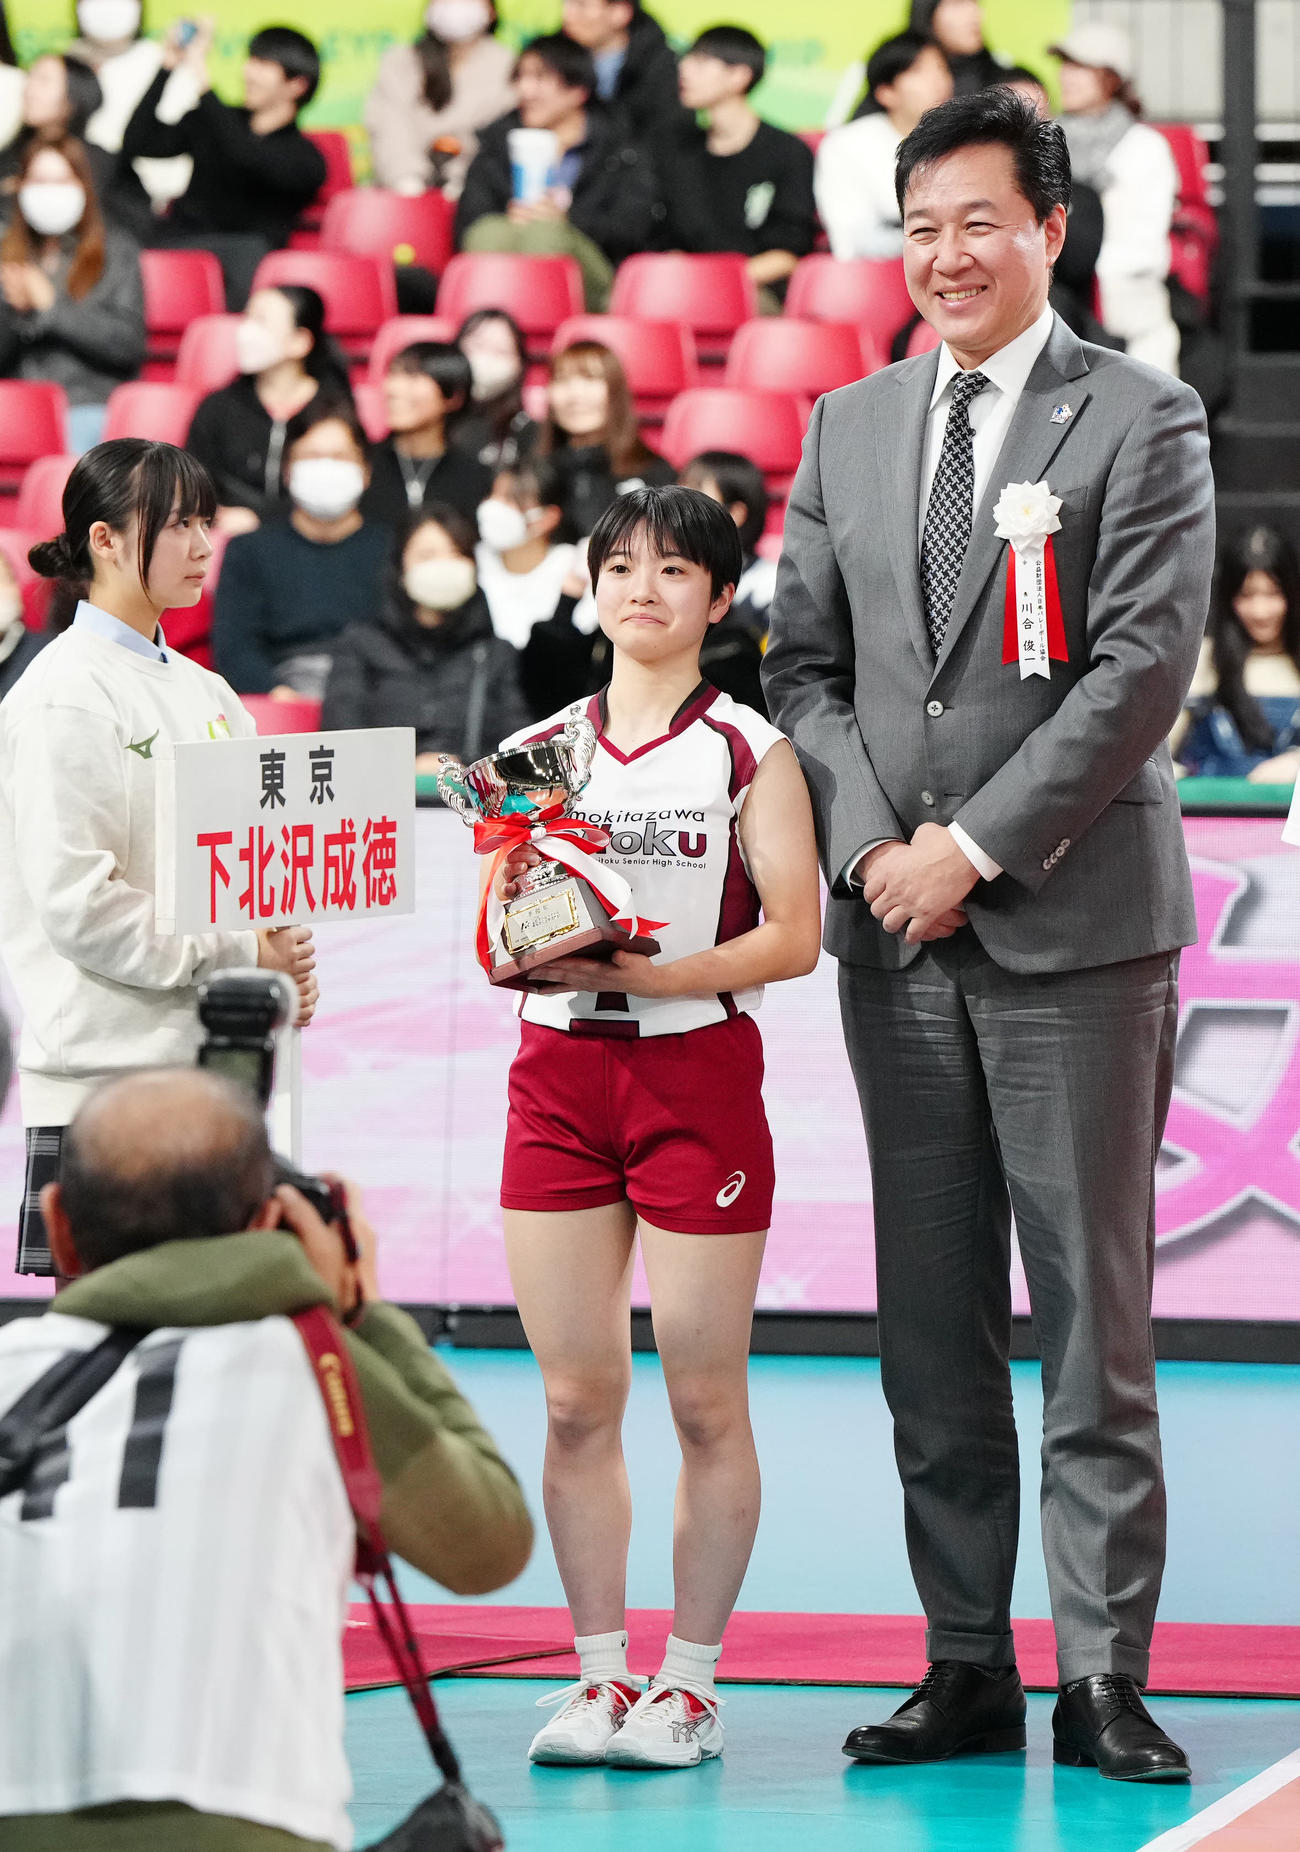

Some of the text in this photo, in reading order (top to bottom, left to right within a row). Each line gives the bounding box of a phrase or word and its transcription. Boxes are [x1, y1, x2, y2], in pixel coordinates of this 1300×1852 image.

[260, 745, 335, 809] 東京
[569, 809, 705, 823] mokitazawa
[197, 816, 397, 923] 下北沢成徳
[652, 858, 672, 867] High
[676, 860, 706, 869] School
